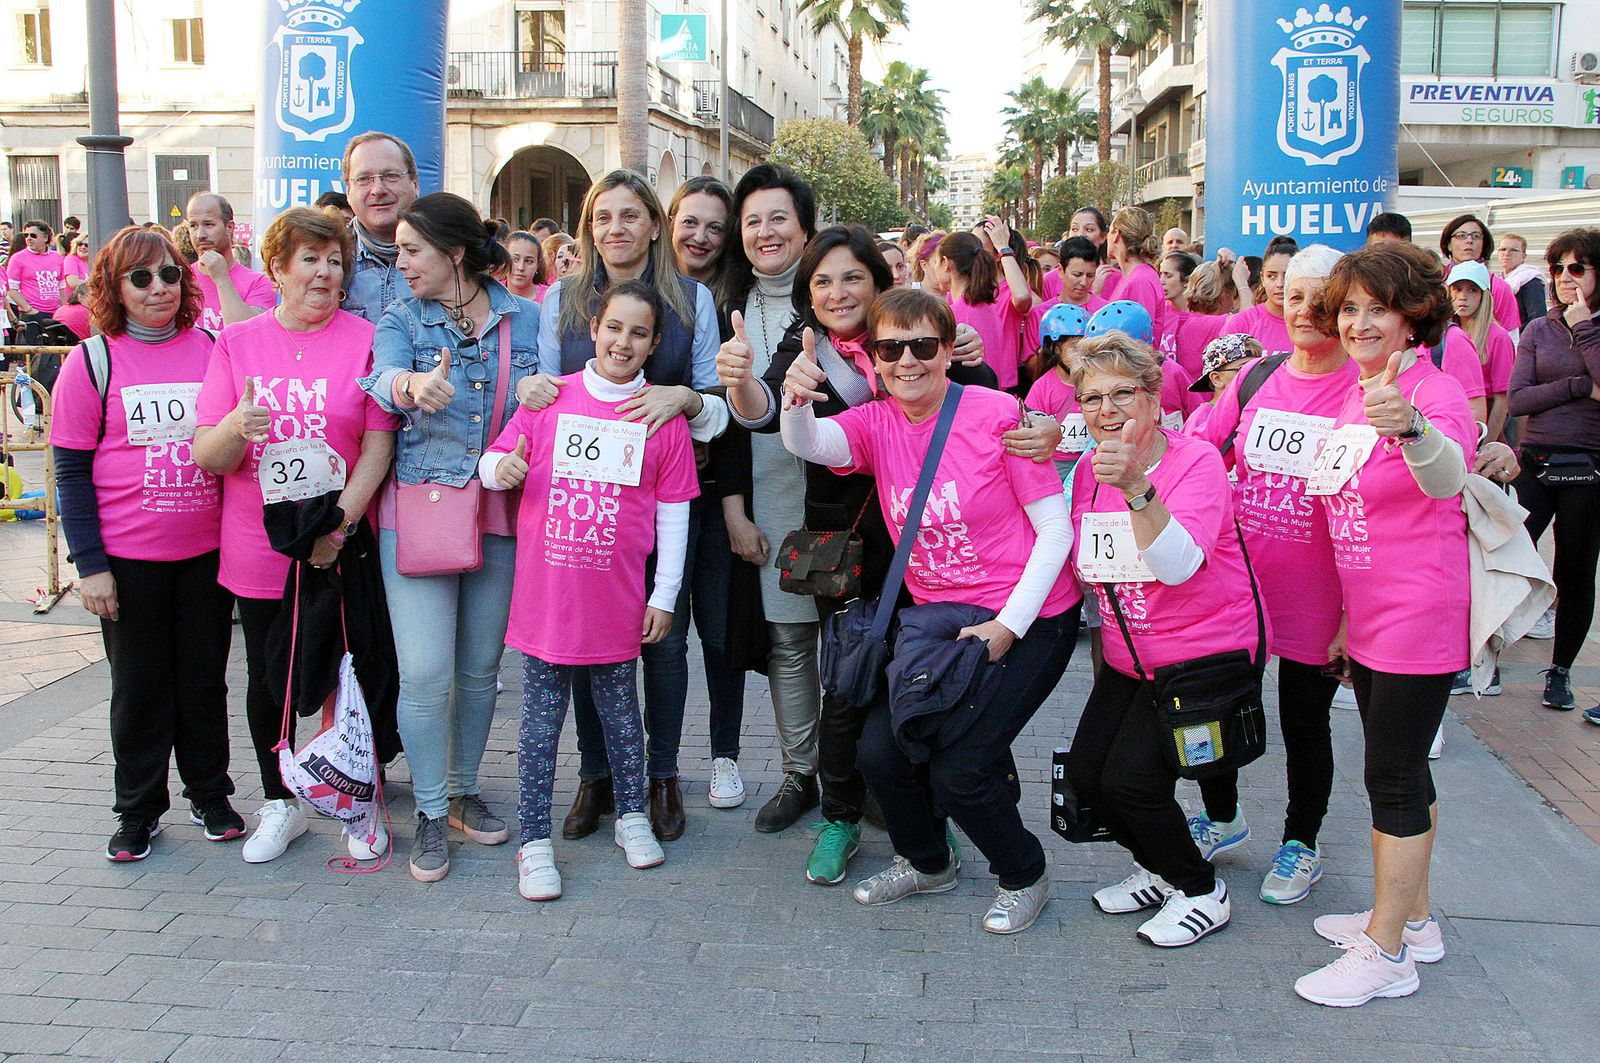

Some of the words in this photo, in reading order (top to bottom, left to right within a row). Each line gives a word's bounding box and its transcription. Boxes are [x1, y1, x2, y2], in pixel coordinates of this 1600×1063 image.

[296, 36, 304, 44] ET
[1303, 58, 1314, 66] ET
[336, 60, 345, 100] CUSTODIA
[1287, 73, 1296, 98] MARIS
[282, 79, 290, 109] PORTUS
[1409, 84, 1555, 102] PREVENTIVA
[1287, 101, 1295, 133] PORTUS
[1461, 107, 1554, 123] SEGUROS
[261, 153, 342, 175] yuntamien
[1495, 167, 1522, 186] 24h
[1242, 177, 1369, 201] Ayuntamiento
[1372, 175, 1388, 193] de
[36, 270, 58, 281] KM
[38, 280, 60, 289] POR
[137, 388, 167, 396] Carrera
[168, 387, 178, 395] de
[253, 376, 327, 412] KM
[130, 399, 185, 425] 410
[1270, 415, 1297, 425] Carrera
[273, 413, 327, 440] OR
[571, 420, 600, 432] Carrera
[601, 425, 611, 433] de
[612, 426, 619, 434] la
[270, 447, 298, 457] Carrera
[300, 444, 309, 452] de
[311, 442, 318, 450] la
[566, 433, 601, 461] 86
[1254, 425, 1306, 455] 108
[145, 441, 196, 467] PO
[271, 458, 308, 485] 32
[1561, 474, 1595, 482] Kalenji
[153, 490, 181, 498] Carrera
[890, 480, 962, 527] KM
[1242, 486, 1314, 517] ELLAS
[1320, 490, 1367, 519] OR
[547, 487, 621, 525] POR
[1121, 518, 1129, 527] la
[1245, 507, 1267, 520] Carrera
[1269, 513, 1279, 522] de
[1280, 516, 1288, 524] la
[1290, 518, 1313, 529] Mujer
[545, 517, 617, 547] ELLAS
[895, 522, 973, 550] OR
[550, 541, 573, 552] Carrera
[585, 547, 593, 555] la
[594, 548, 614, 557] Mujer
[1092, 533, 1116, 560] 13
[1352, 545, 1372, 554] Mujer
[941, 571, 951, 579] de
[953, 566, 962, 576] la
[963, 563, 984, 574] Mujer
[1131, 621, 1153, 630] Mujer
